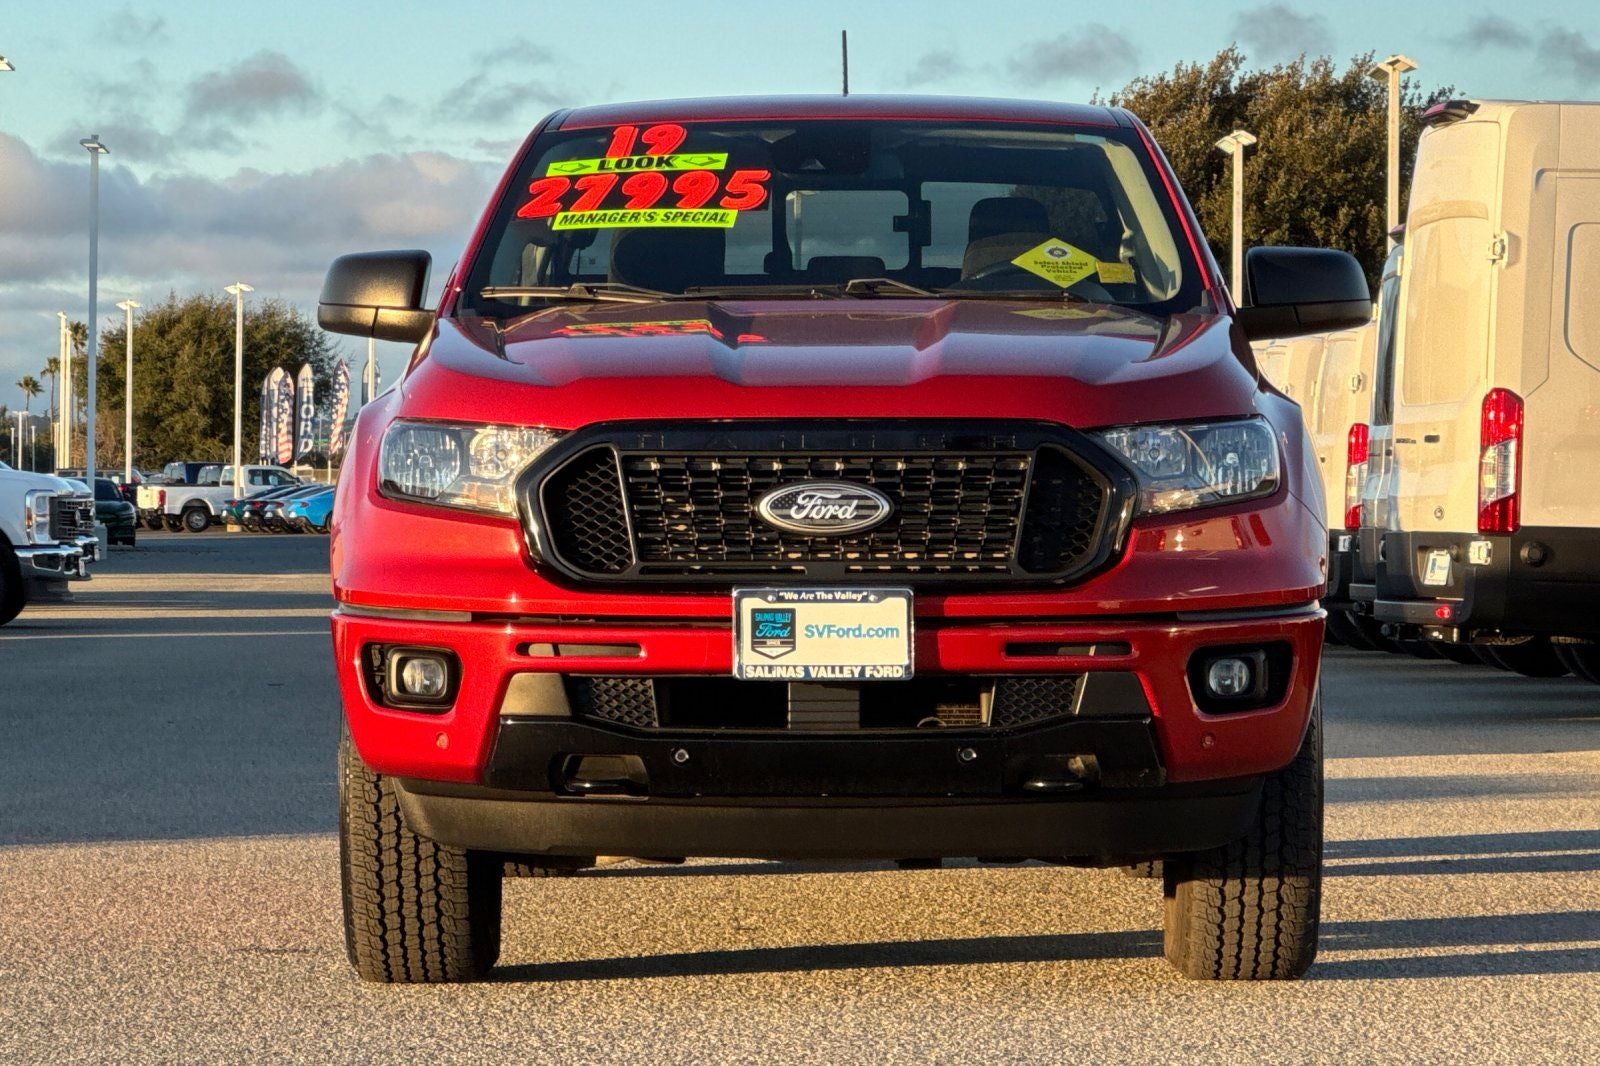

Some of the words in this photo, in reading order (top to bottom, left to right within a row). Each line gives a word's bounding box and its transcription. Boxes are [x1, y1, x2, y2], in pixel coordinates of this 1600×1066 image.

[605, 124, 687, 158] 19
[597, 155, 680, 171] LOOK
[517, 170, 772, 218] 27995
[559, 211, 657, 226] MANAGER'S
[661, 211, 729, 225] SPECIAL
[790, 492, 858, 519] Ford
[800, 591, 815, 600] Are
[815, 591, 834, 600] The
[756, 622, 792, 637] Ford
[804, 624, 899, 638] SVFord.com
[746, 666, 805, 678] SALINAS
[809, 666, 861, 678] VALLEY
[865, 666, 902, 678] FORD
